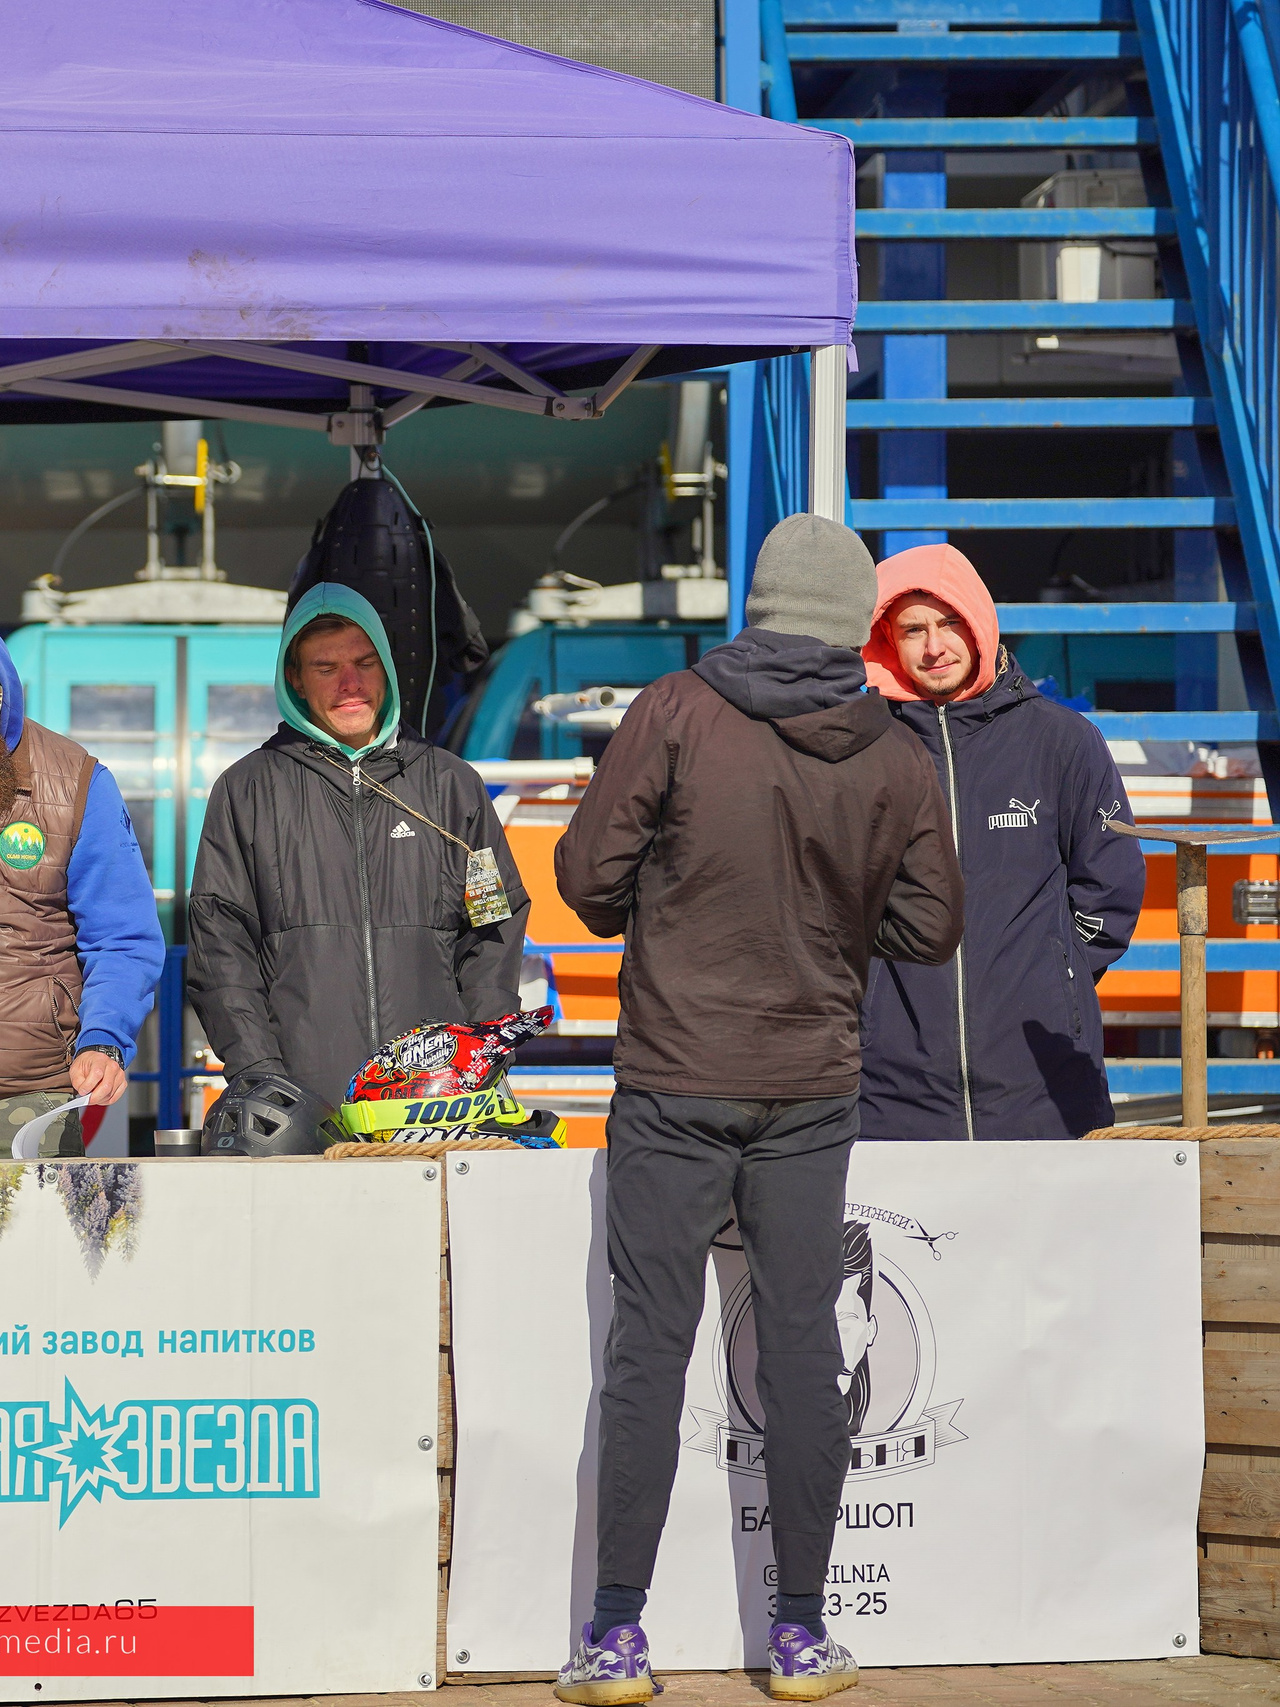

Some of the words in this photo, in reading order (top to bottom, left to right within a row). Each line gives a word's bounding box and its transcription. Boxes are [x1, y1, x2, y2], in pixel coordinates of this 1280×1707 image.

[404, 1091, 495, 1125] 100%
[42, 1329, 144, 1358] завод
[158, 1329, 316, 1354] напитков
[118, 1403, 315, 1493] ЗВЕЗДА
